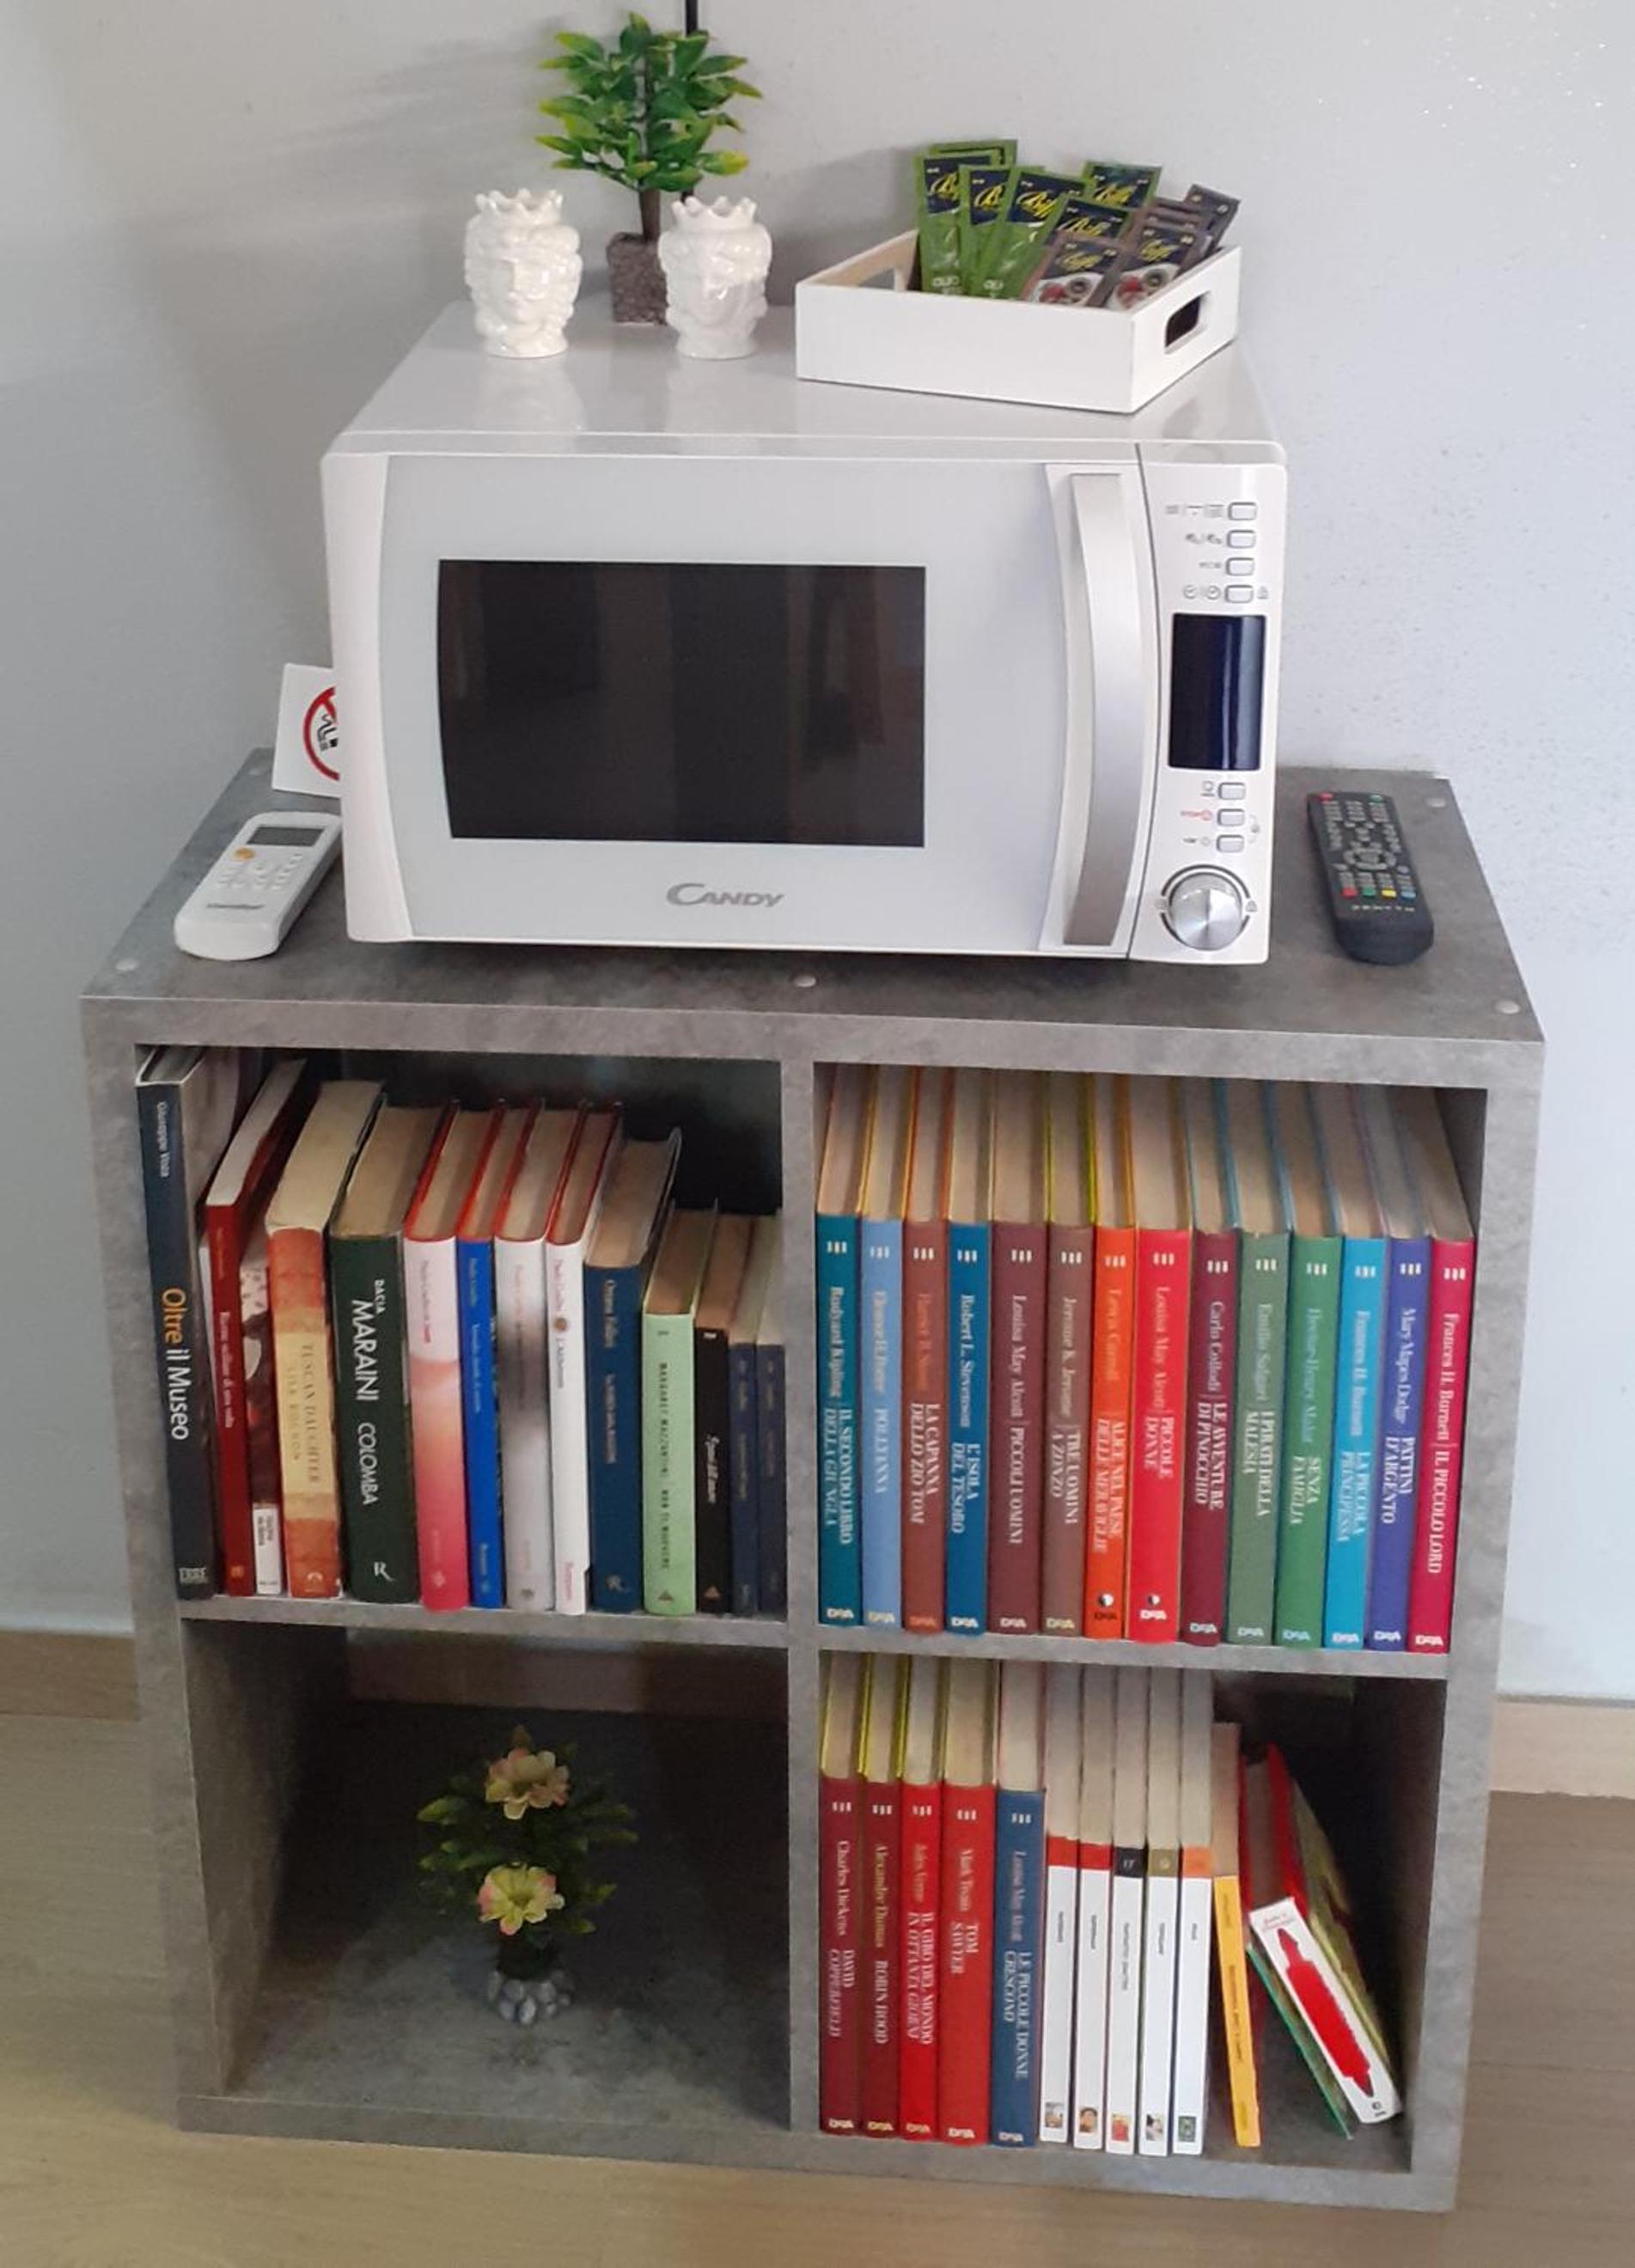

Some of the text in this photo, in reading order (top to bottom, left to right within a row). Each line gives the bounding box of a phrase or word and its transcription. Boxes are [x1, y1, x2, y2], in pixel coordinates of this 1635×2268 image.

[666, 882, 785, 907] CANDY
[374, 1278, 386, 1314] DACIA
[1154, 1286, 1171, 1333] Louisa
[1399, 1308, 1417, 1339] Mary
[162, 1288, 192, 1441] Oltre il Museo
[302, 1344, 316, 1399] TUSCAN
[827, 1286, 845, 1398] Rudyard Kipling
[960, 1295, 975, 1428] Robert L. Stevenson
[1060, 1296, 1077, 1417] Jerome K. Jerome
[1207, 1302, 1225, 1392] Carlo Collodi
[1395, 1341, 1414, 1382] Mapes
[351, 1299, 380, 1506] MARAINI COLOMBA
[1009, 1295, 1028, 1544] Louisa May Alcott PICCOLI UOMINI
[1144, 1416, 1159, 1470] DONNE
[1158, 1417, 1175, 1478] PICCOLE
[1242, 1411, 1258, 1474] MALESIA
[1259, 1418, 1274, 1466] PIRATI
[1427, 1313, 1461, 1574] Frances H. Burnett IL PICCOLO LORD
[824, 1408, 839, 1527] DELLA GIUNGLA
[839, 1410, 854, 1544] IL SECONDO LIBRO
[873, 1408, 890, 1494] POLLYANNA
[911, 1403, 925, 1524] DELLO ZIO TOM
[925, 1404, 941, 1495] LA CAPANNA
[951, 1442, 965, 1533] DEL TESORO
[1050, 1443, 1064, 1498] ZONZO
[1065, 1430, 1081, 1525] TRE UOMINI
[1093, 1418, 1110, 1552] DELLE MERAVIGLIE
[1109, 1420, 1126, 1539] ALICE NEL PAESE
[1194, 1402, 1211, 1504] DI PINOCCHIO
[1210, 1403, 1227, 1510] LE AVVENTURE
[1257, 1468, 1272, 1516] DELLA
[1290, 1455, 1305, 1525] FAMIGLIA
[1306, 1456, 1321, 1504] SENZA
[1353, 1451, 1371, 1535] LA PICCOLA
[1381, 1436, 1400, 1525] D'ARGENTO
[1400, 1436, 1416, 1495] PATTINI
[1337, 1451, 1355, 1543] PRINCIPESSA
[837, 1840, 851, 1936] Charles Dickens
[842, 1949, 856, 1988] DAVID
[874, 1844, 889, 2045] Alexandre Dumas ROBIN HOOD
[906, 1911, 920, 2039] IN OTTANTA GIORNI
[919, 1912, 934, 2045] IL GIRO DEL MONDO
[950, 1921, 966, 1974] SAWYER
[966, 1924, 980, 1954] TOM
[827, 1948, 842, 2037] COPPERFIELD
[1004, 1950, 1017, 2022] CRESCONO
[1016, 1951, 1033, 2079] LE PICCOLE DONNE
